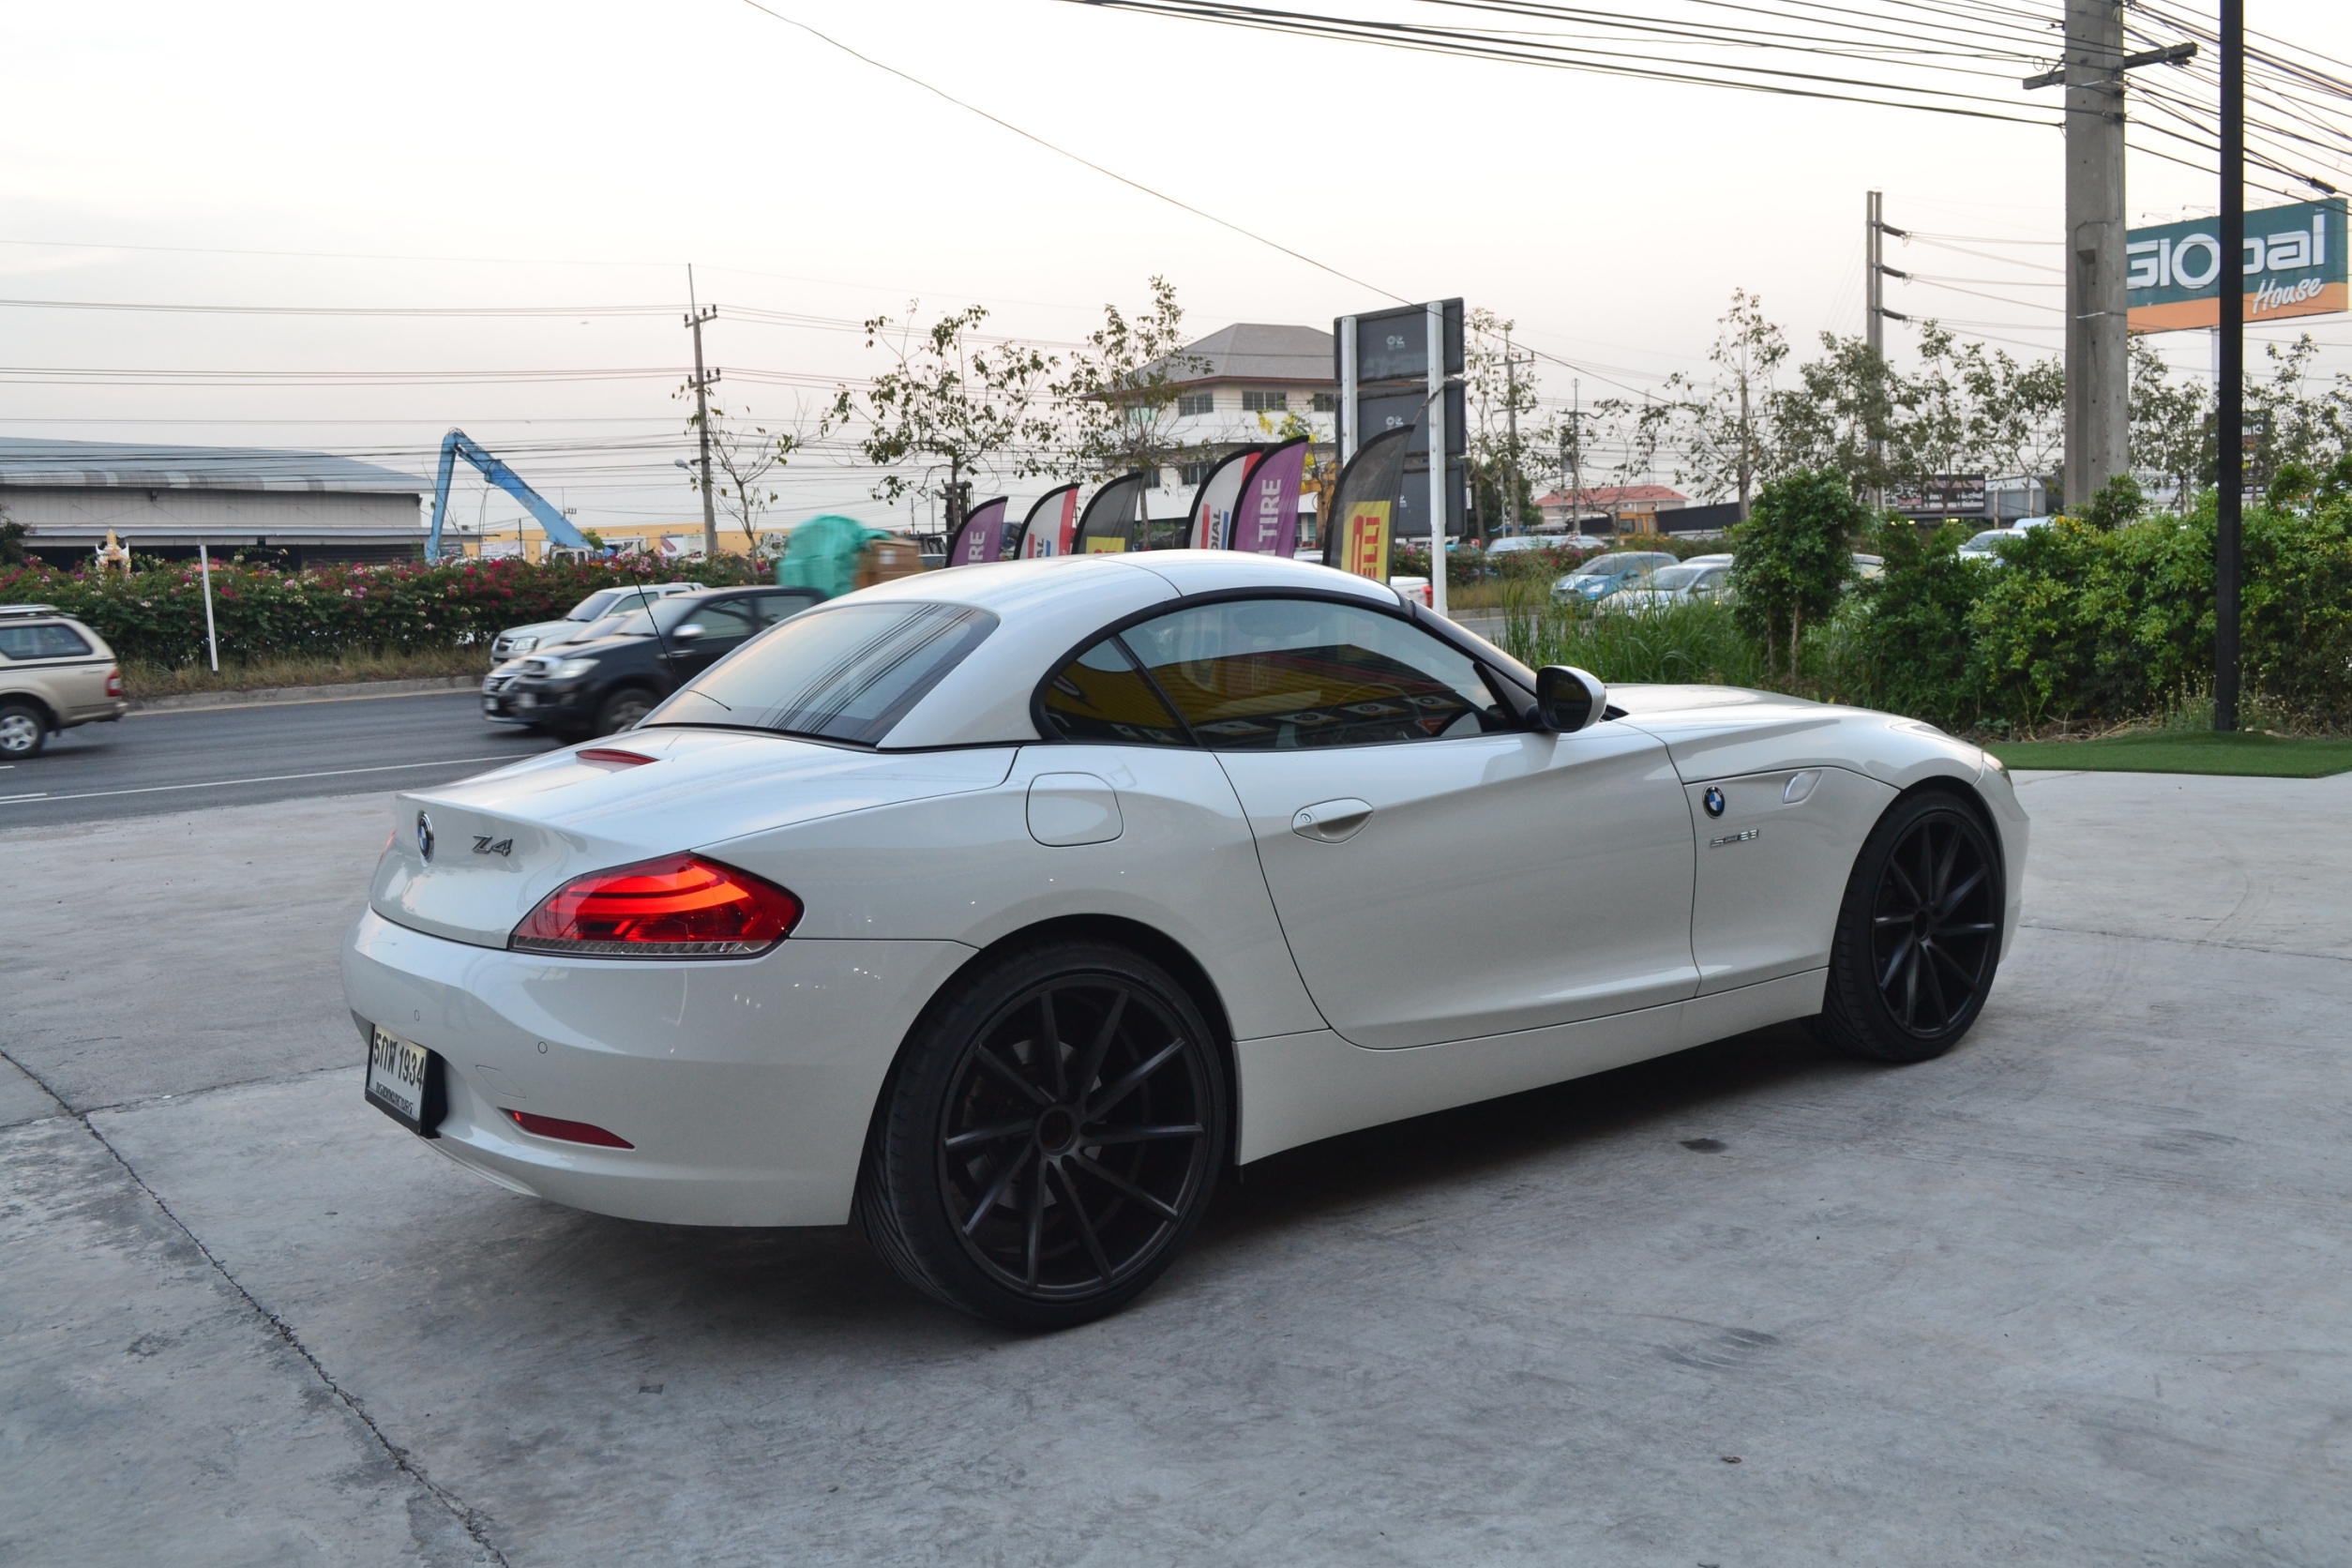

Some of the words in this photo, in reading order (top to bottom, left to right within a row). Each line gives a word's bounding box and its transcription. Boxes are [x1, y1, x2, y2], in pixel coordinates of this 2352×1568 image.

[2253, 278, 2325, 315] House
[1259, 479, 1282, 543] TIRE
[968, 531, 985, 564] RE
[472, 834, 513, 856] Z4
[399, 1046, 425, 1092] 1934
